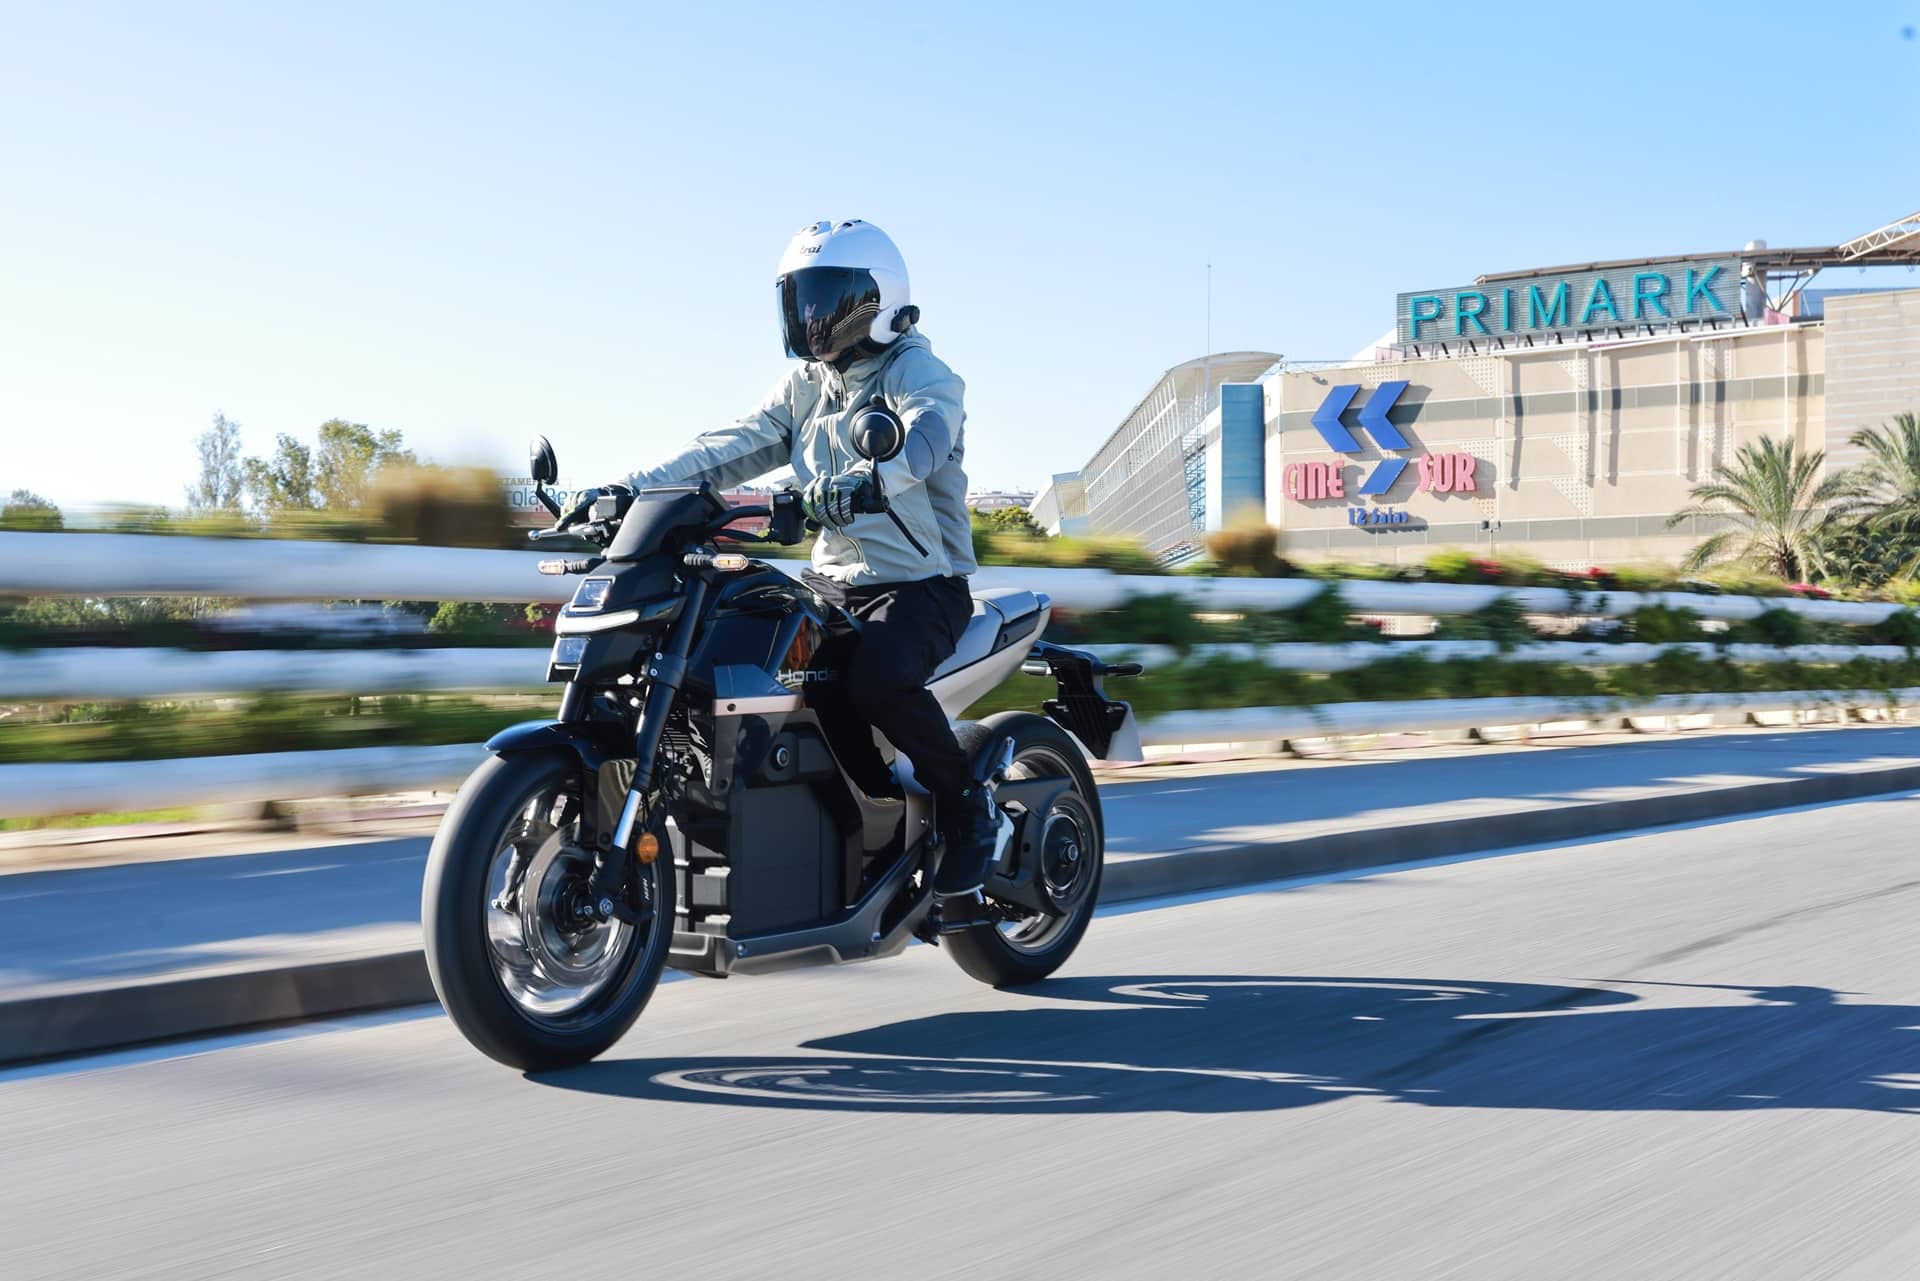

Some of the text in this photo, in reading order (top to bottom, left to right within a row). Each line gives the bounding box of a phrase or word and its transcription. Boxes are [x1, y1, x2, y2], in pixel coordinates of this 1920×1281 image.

[1410, 265, 1725, 340] PRIMARK
[1282, 453, 1476, 500] CINE SUR
[1348, 508, 1367, 525] 12
